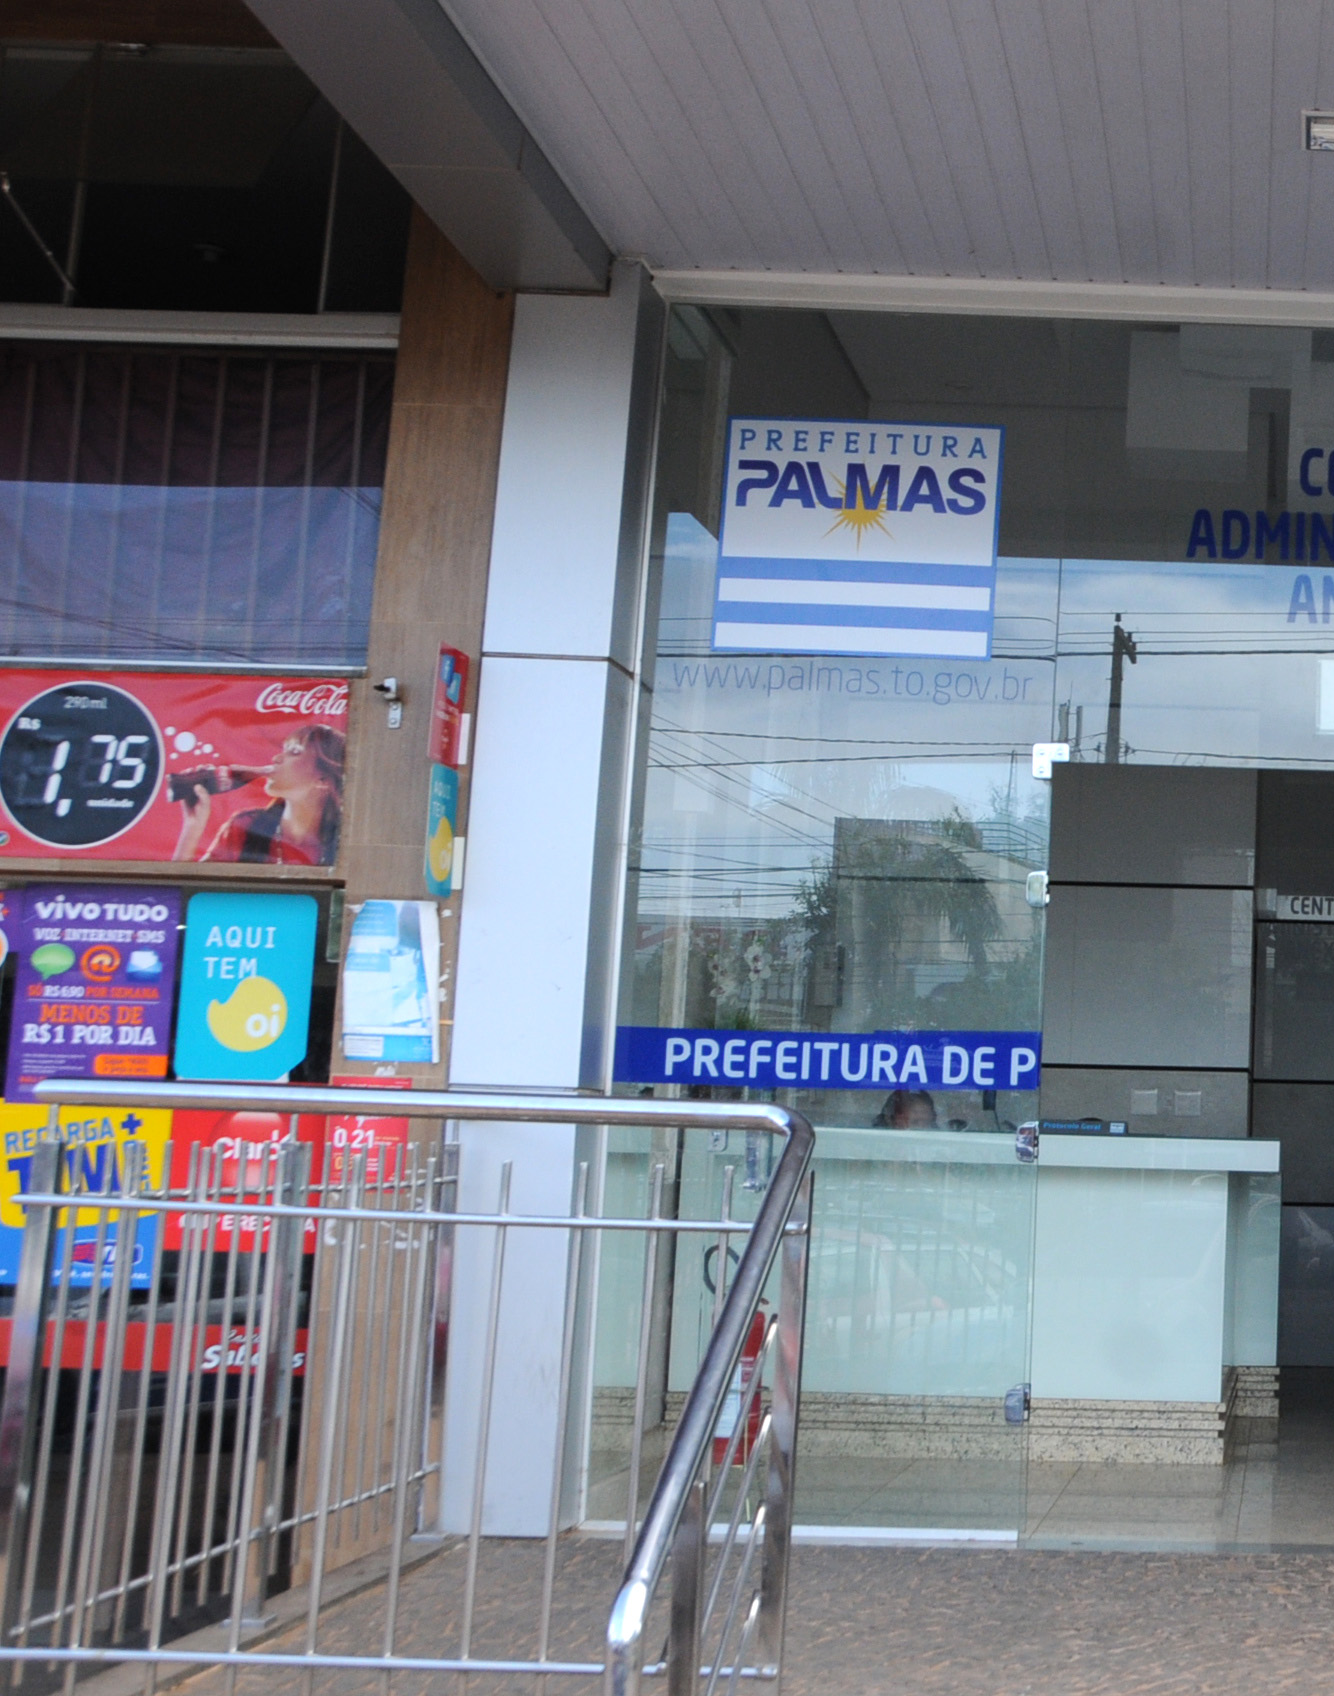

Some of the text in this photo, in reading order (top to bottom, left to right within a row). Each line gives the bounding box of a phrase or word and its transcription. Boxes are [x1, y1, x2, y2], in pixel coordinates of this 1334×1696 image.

[738, 428, 988, 460] PREFEITURA
[735, 460, 987, 516] PALMAS
[673, 661, 1033, 706] www.palmas.to.gov.br
[255, 682, 348, 715] Coca-Cola
[103, 903, 169, 922] TUDO
[205, 926, 277, 948] AQUI
[203, 957, 258, 979] TEM
[40, 1004, 144, 1025] MENOS DE
[71, 1025, 114, 1045] POR
[117, 1026, 157, 1046] DIA
[664, 1037, 1036, 1086] PREFEITURA DE P
